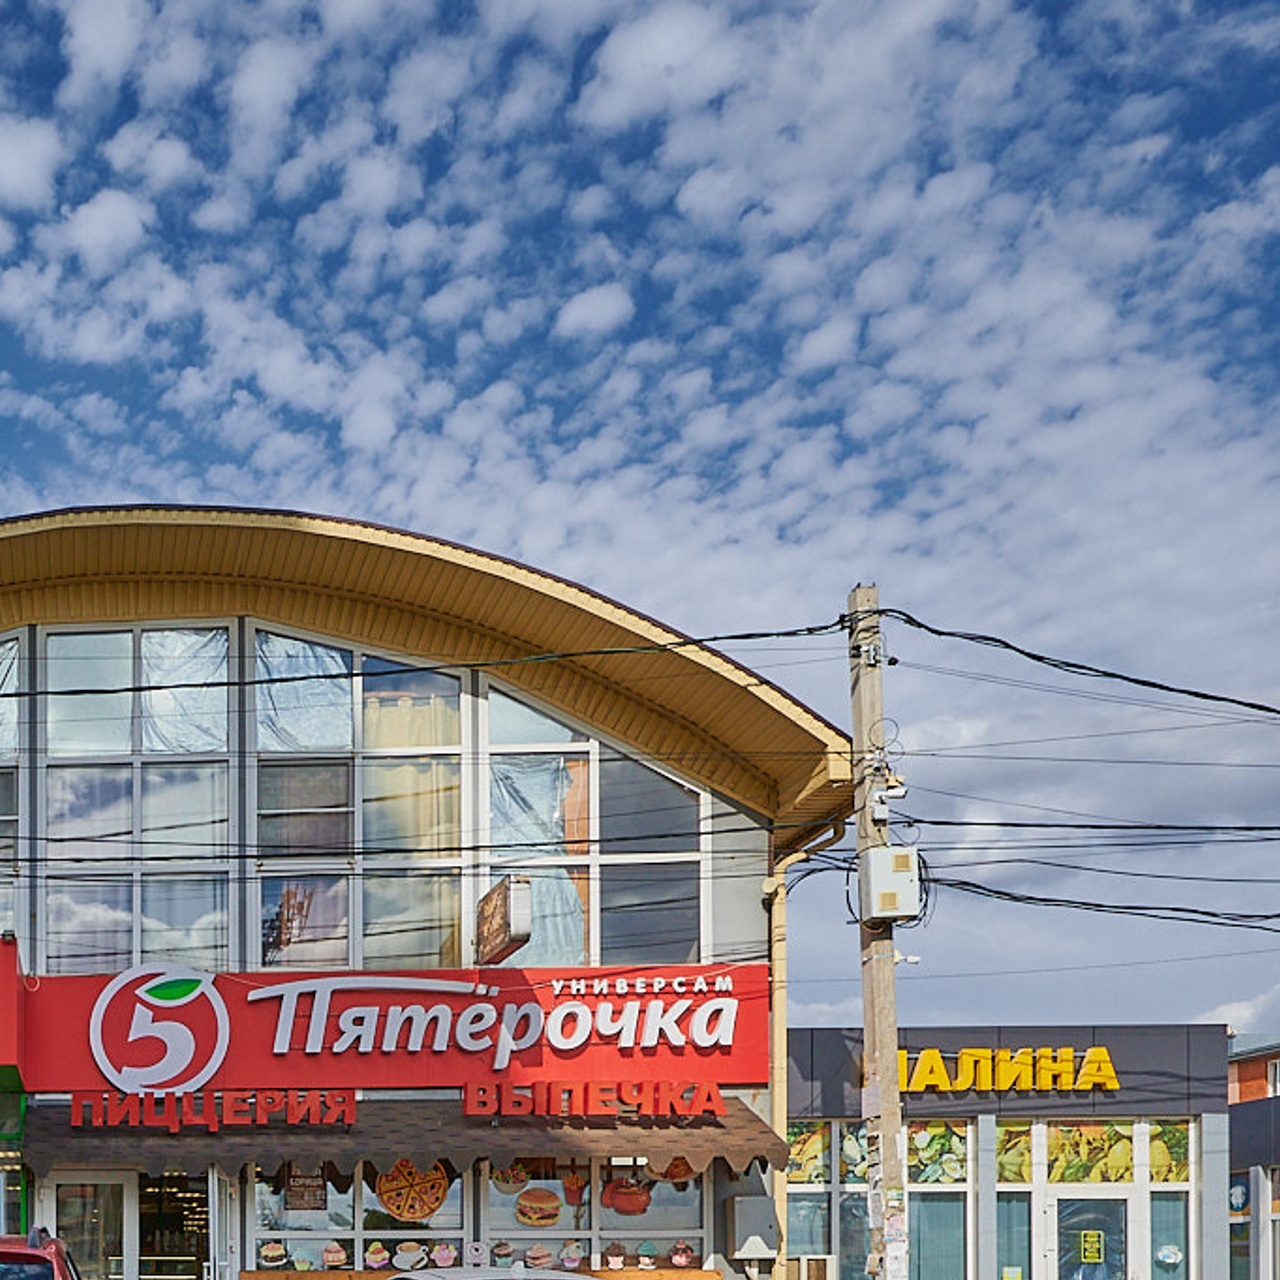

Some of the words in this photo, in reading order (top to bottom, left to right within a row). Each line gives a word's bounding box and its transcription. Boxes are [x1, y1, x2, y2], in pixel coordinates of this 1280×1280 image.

[551, 976, 735, 995] УНИВЕРСАМ
[247, 976, 740, 1071] Пятёрочка
[862, 1046, 1121, 1092] АЛИНА
[70, 1090, 357, 1134] ПИЦЦЕРИЯ
[464, 1081, 728, 1117] ВЫПЕЧКА
